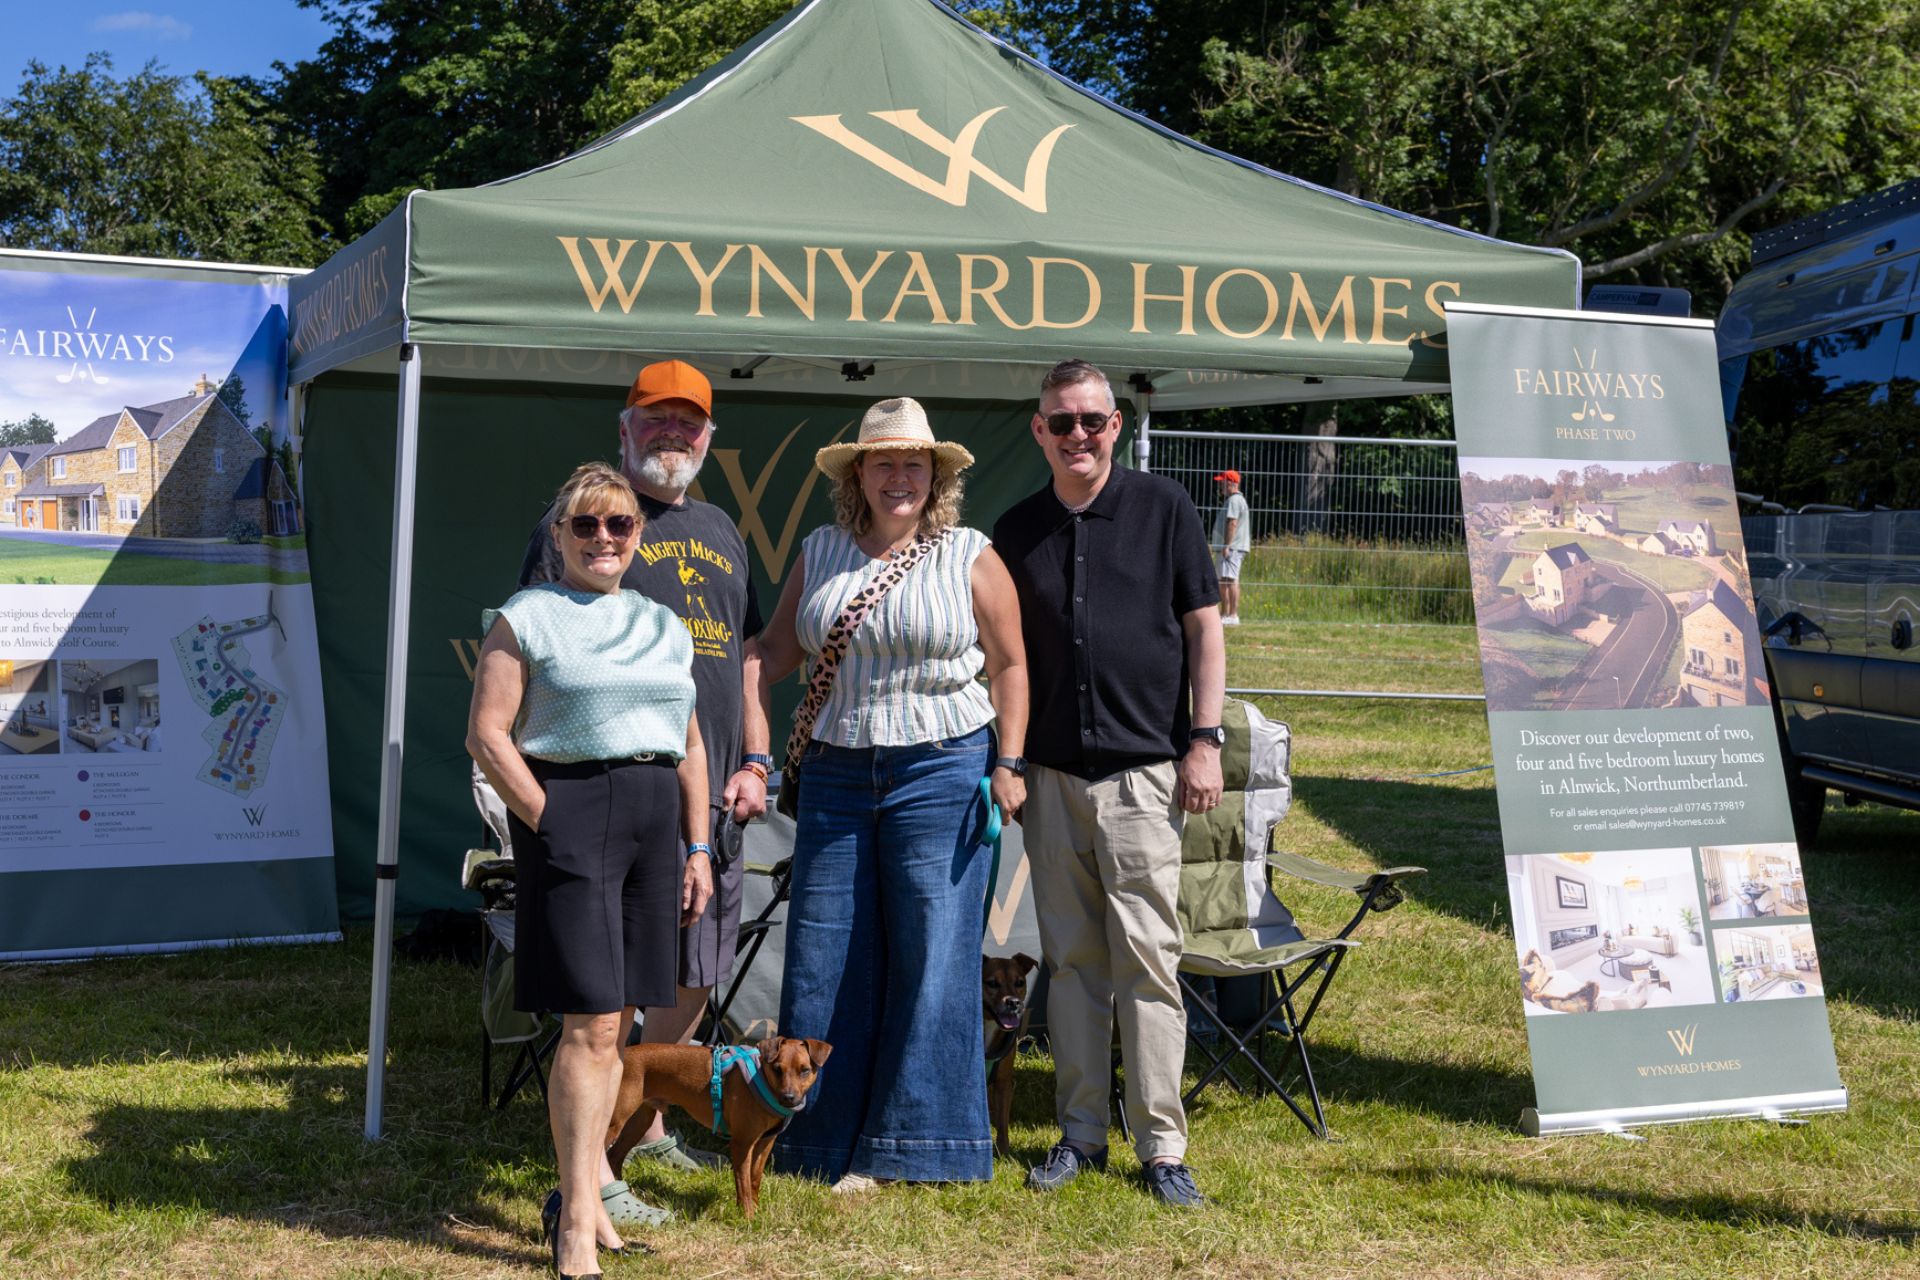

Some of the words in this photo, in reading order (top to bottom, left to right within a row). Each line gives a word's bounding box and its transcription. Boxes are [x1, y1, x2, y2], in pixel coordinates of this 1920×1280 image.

[556, 235, 1101, 330] WYNYARD
[1129, 262, 1461, 349] HOMES
[1514, 368, 1665, 400] FAIRWAYS
[1556, 427, 1599, 440] PHASE
[1603, 429, 1636, 441] TWO
[636, 541, 687, 566] MIGHTY
[41, 608, 103, 622] development
[106, 607, 118, 618] of
[11, 622, 29, 633] and
[33, 622, 50, 633] five
[53, 622, 96, 633] bedroom
[100, 622, 129, 636] luxury
[1, 639, 11, 647] to
[14, 637, 54, 648] Alnwick
[58, 637, 80, 648] Golf
[1520, 729, 1582, 746] Discover
[1585, 733, 1609, 745] our
[1613, 727, 1702, 748] development
[1705, 723, 1721, 741] of
[1724, 728, 1754, 741] two,
[1516, 753, 1545, 771] four
[1548, 752, 1576, 770] and
[1578, 752, 1603, 769] five
[1606, 750, 1670, 768] bedroom
[1673, 749, 1718, 770] luxury
[1721, 747, 1765, 764] homes
[1540, 780, 1555, 795] in
[1559, 776, 1621, 795] Alnwick,
[1623, 771, 1748, 792] Northumberland.
[1550, 807, 1564, 818] For
[1566, 807, 1576, 817] all
[1577, 807, 1598, 817] sales
[1600, 805, 1639, 818] enquiries
[1640, 804, 1668, 817] please
[1669, 803, 1683, 813] call
[1684, 802, 1712, 812] 07745
[1713, 800, 1745, 811] 739819
[1573, 823, 1582, 831] or
[1584, 820, 1607, 832] email
[1608, 816, 1727, 832] sales@wynyard-homes.co.uk
[214, 831, 264, 841] WYNYARD
[266, 828, 301, 839] HOMES
[1637, 1062, 1699, 1077] WYNYARD
[1700, 1059, 1742, 1072] HOMES
